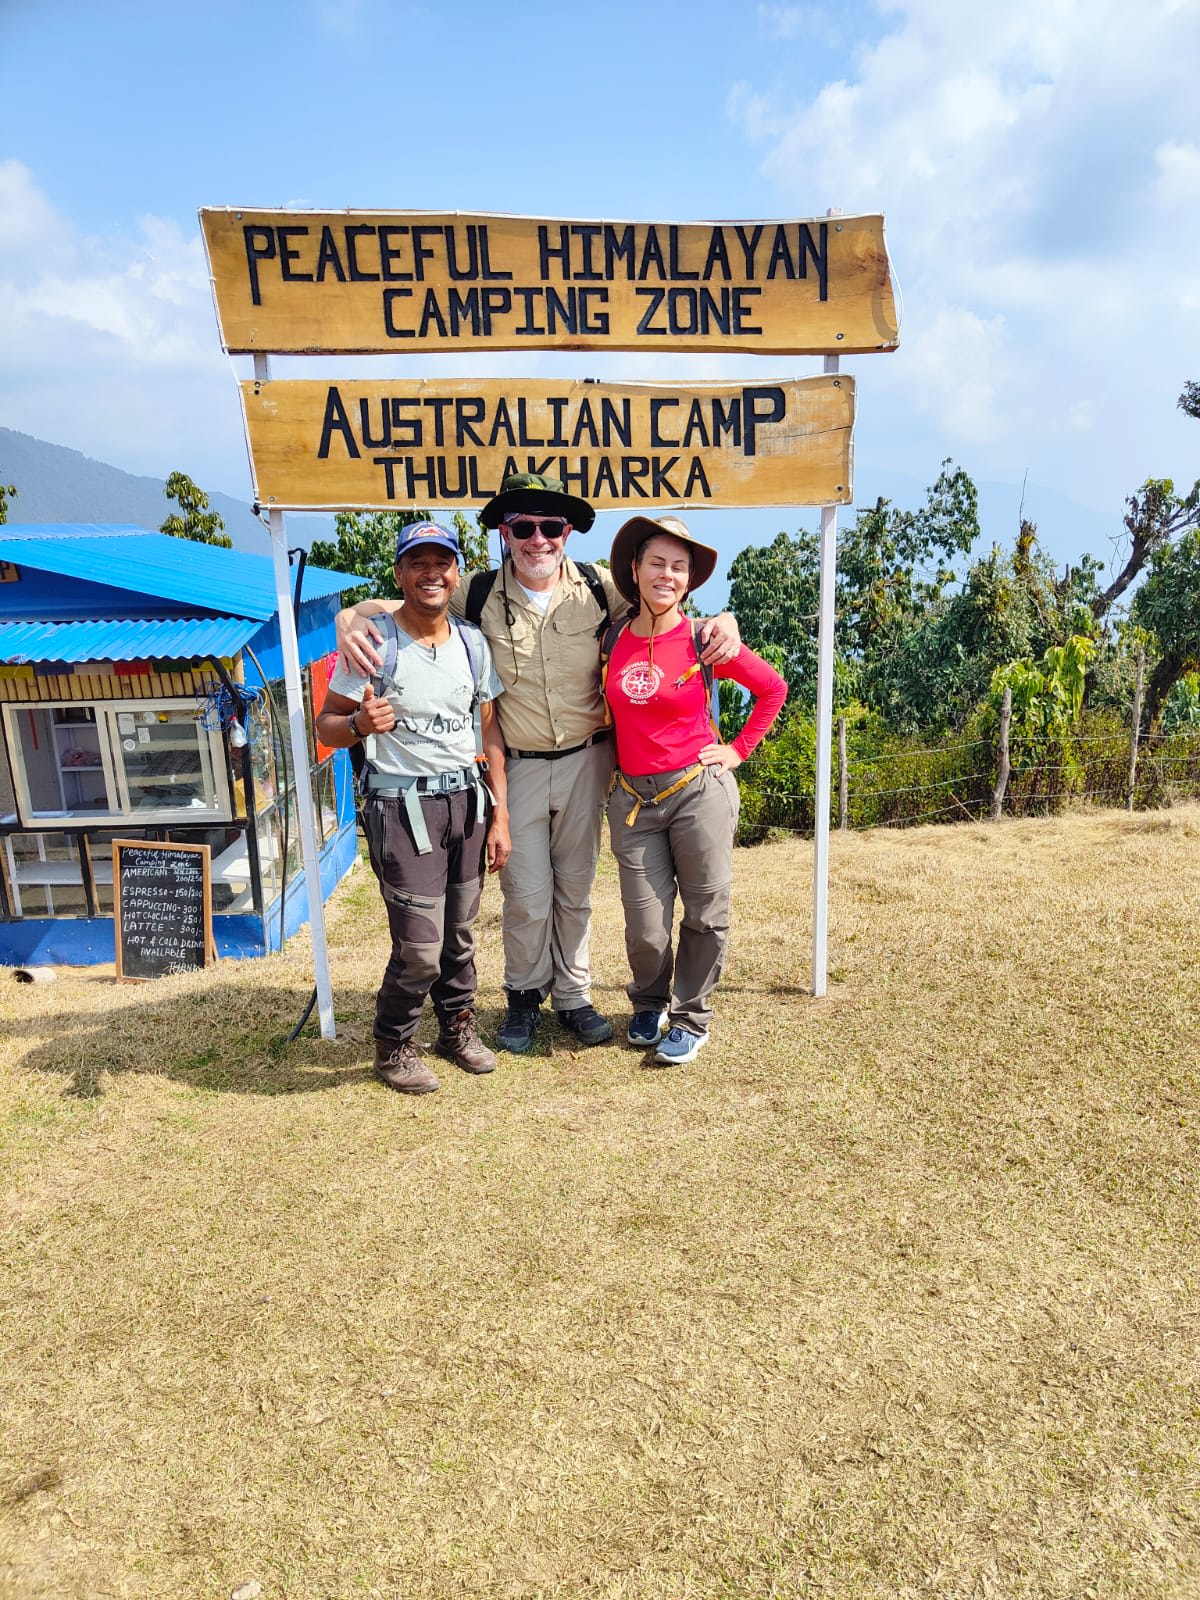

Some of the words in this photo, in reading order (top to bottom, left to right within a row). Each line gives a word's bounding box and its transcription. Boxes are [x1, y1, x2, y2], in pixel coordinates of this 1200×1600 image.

[243, 224, 513, 306] PEACEFUL
[538, 222, 828, 302] HIMALAYAN
[383, 286, 610, 337] CAMPING
[636, 287, 762, 336] ZONE
[318, 386, 631, 459] AUSTRALIAN
[650, 386, 786, 457] CAMP
[621, 661, 649, 676] OUTWARD
[650, 664, 665, 678] OUND
[135, 857, 166, 867] Camping
[122, 886, 168, 896] ESPRESSO
[124, 911, 142, 920] HOT
[123, 921, 164, 932] LATTEE
[127, 935, 146, 945] HOT
[158, 936, 178, 946] COLD
[140, 947, 186, 959] AVAILABLE
